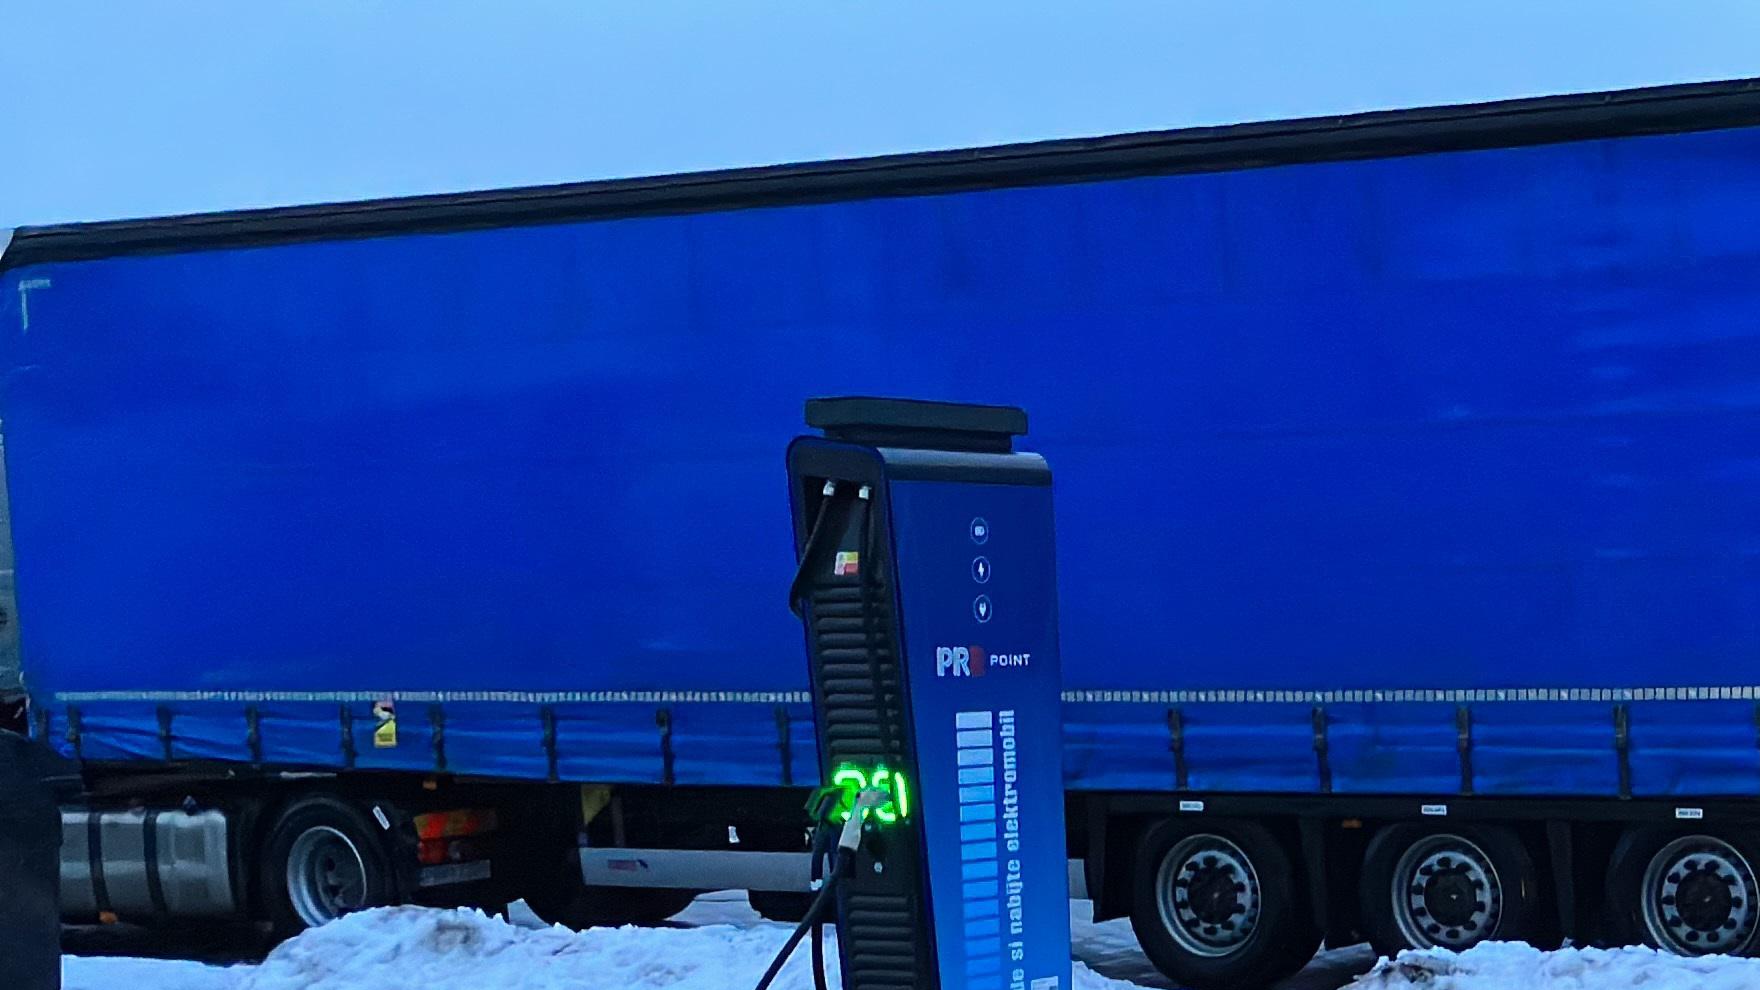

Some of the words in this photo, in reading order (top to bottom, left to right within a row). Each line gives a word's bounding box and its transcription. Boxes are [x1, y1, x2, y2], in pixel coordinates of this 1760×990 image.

[989, 653, 1031, 667] POINT
[999, 709, 1020, 852] elektromobil
[1006, 859, 1024, 934] nabijte
[1008, 941, 1024, 961] si
